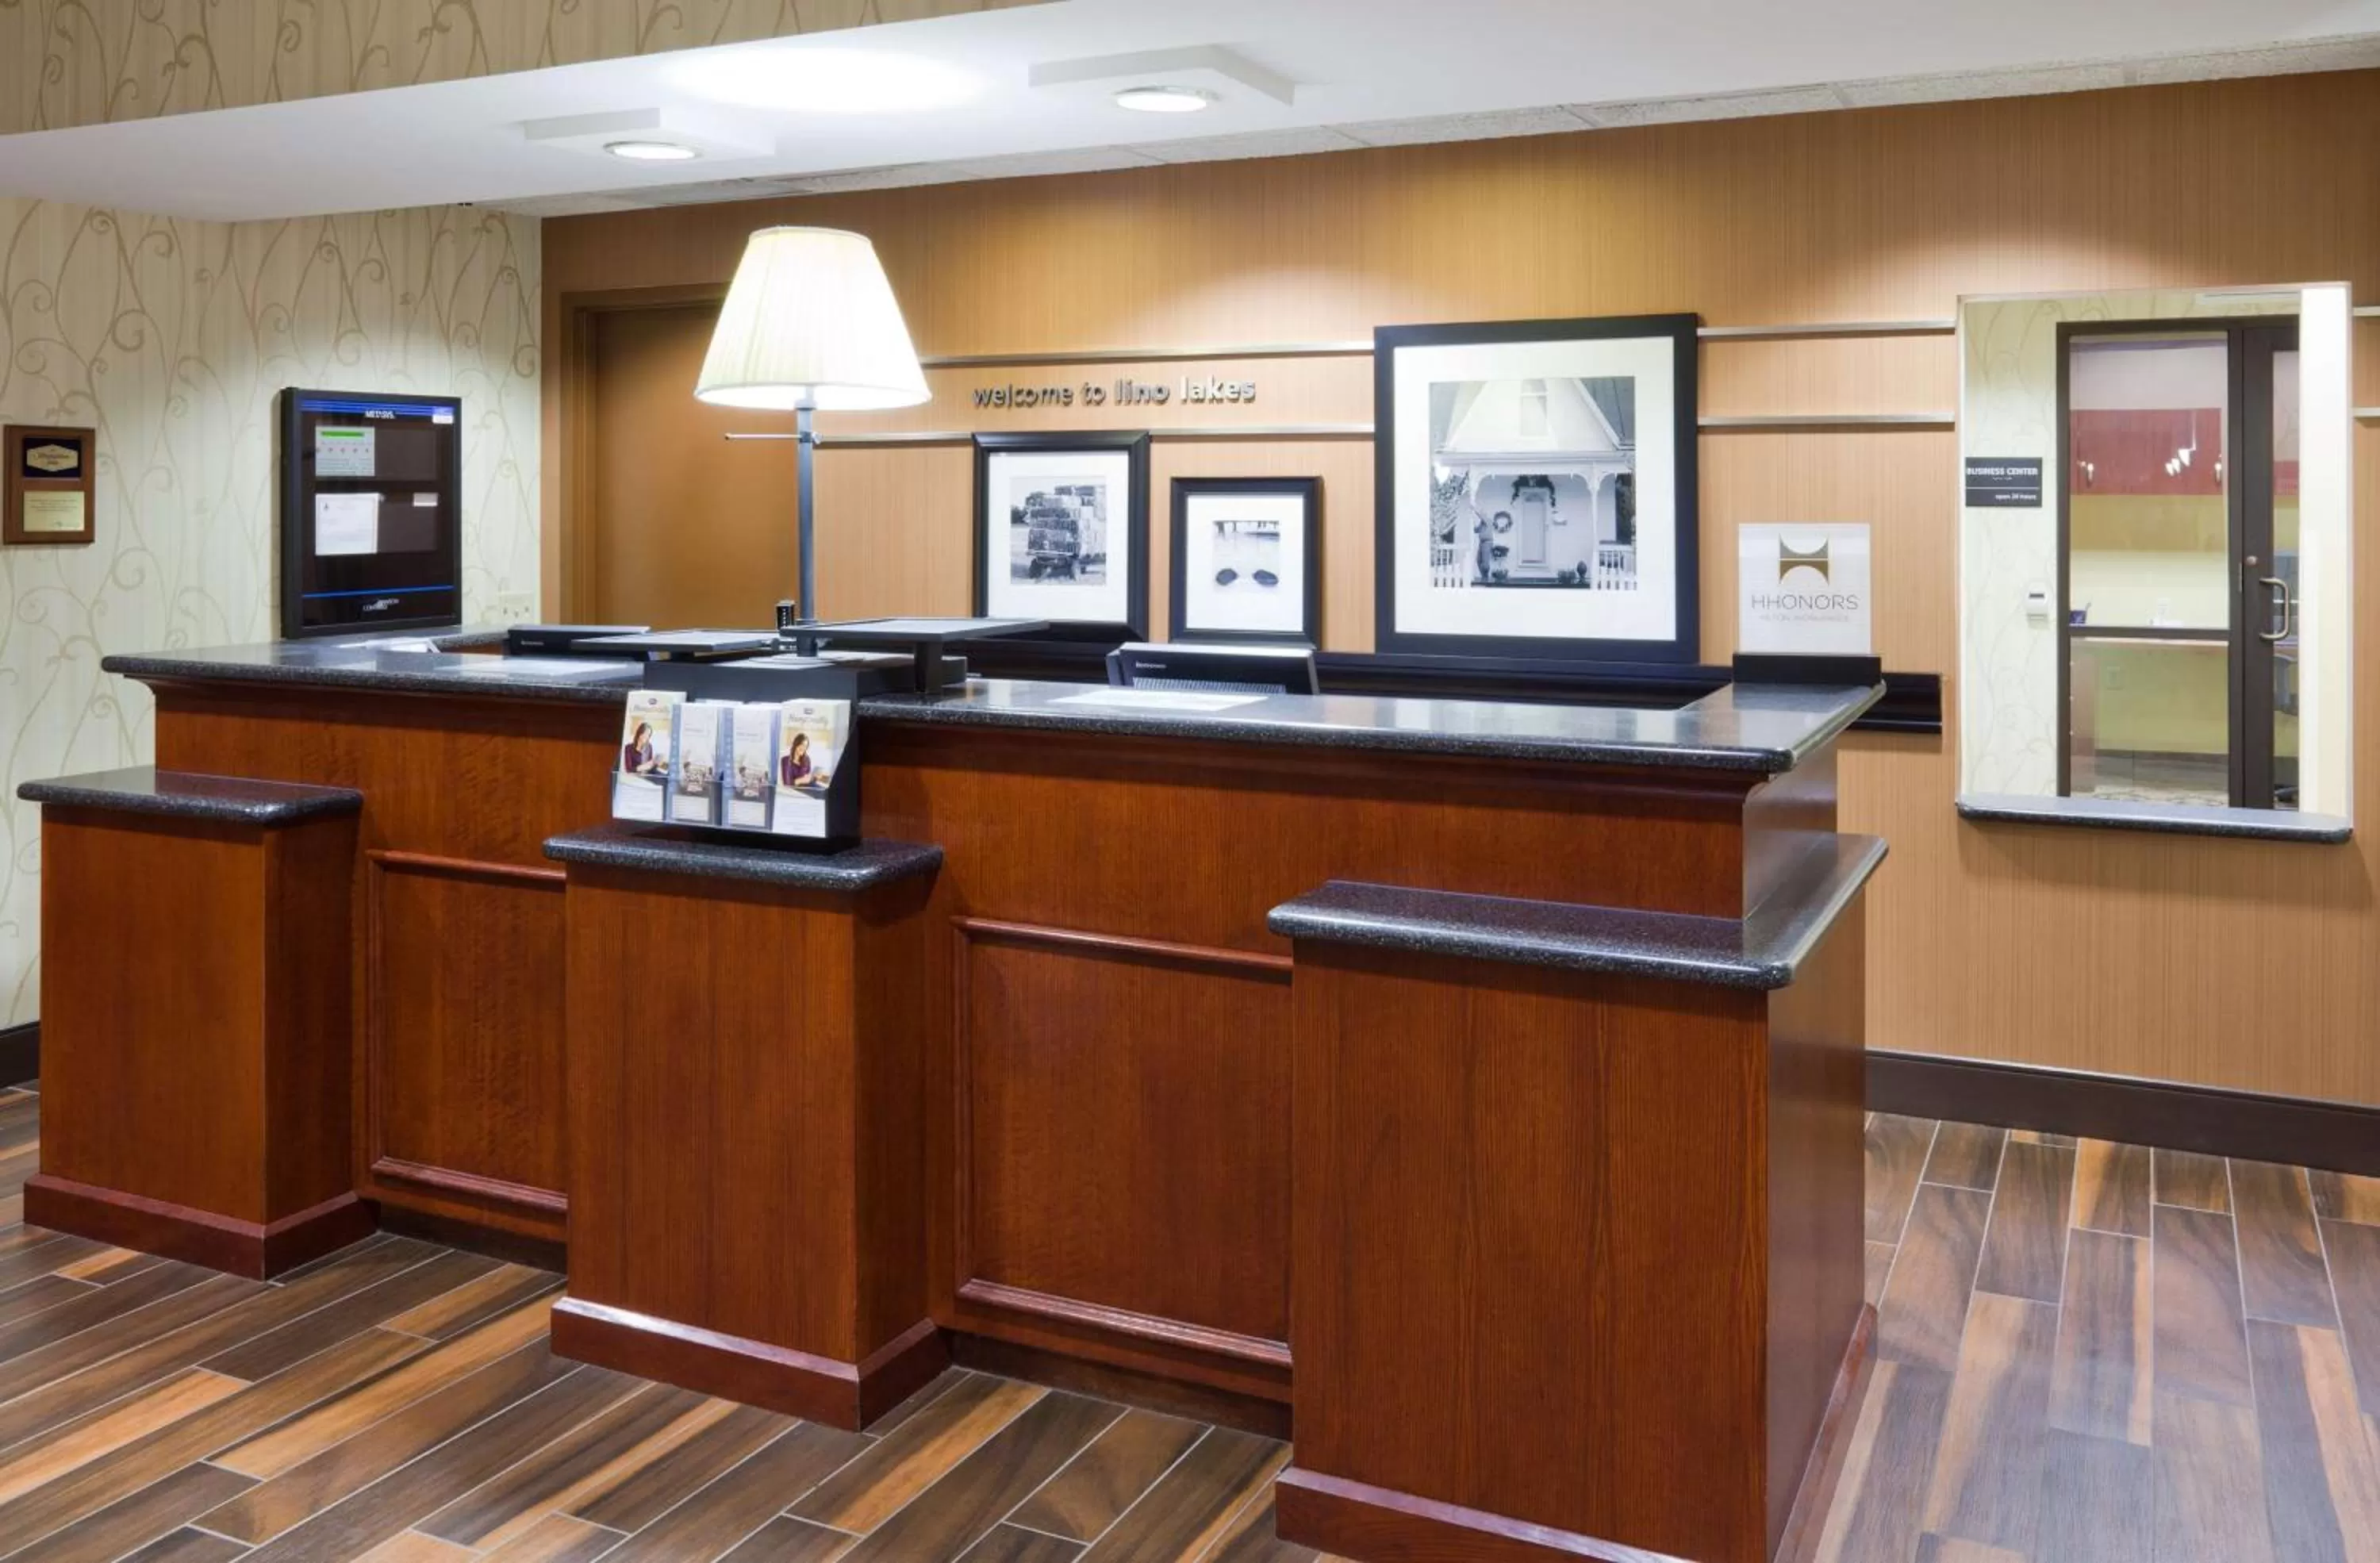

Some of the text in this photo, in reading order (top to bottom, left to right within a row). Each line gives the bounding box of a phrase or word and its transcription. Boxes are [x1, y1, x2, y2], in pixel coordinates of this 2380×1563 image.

[973, 374, 1257, 409] welcome to lino lakes
[1967, 467, 2038, 475] BUSINESS CENTER
[1751, 594, 1859, 610] HHONORS
